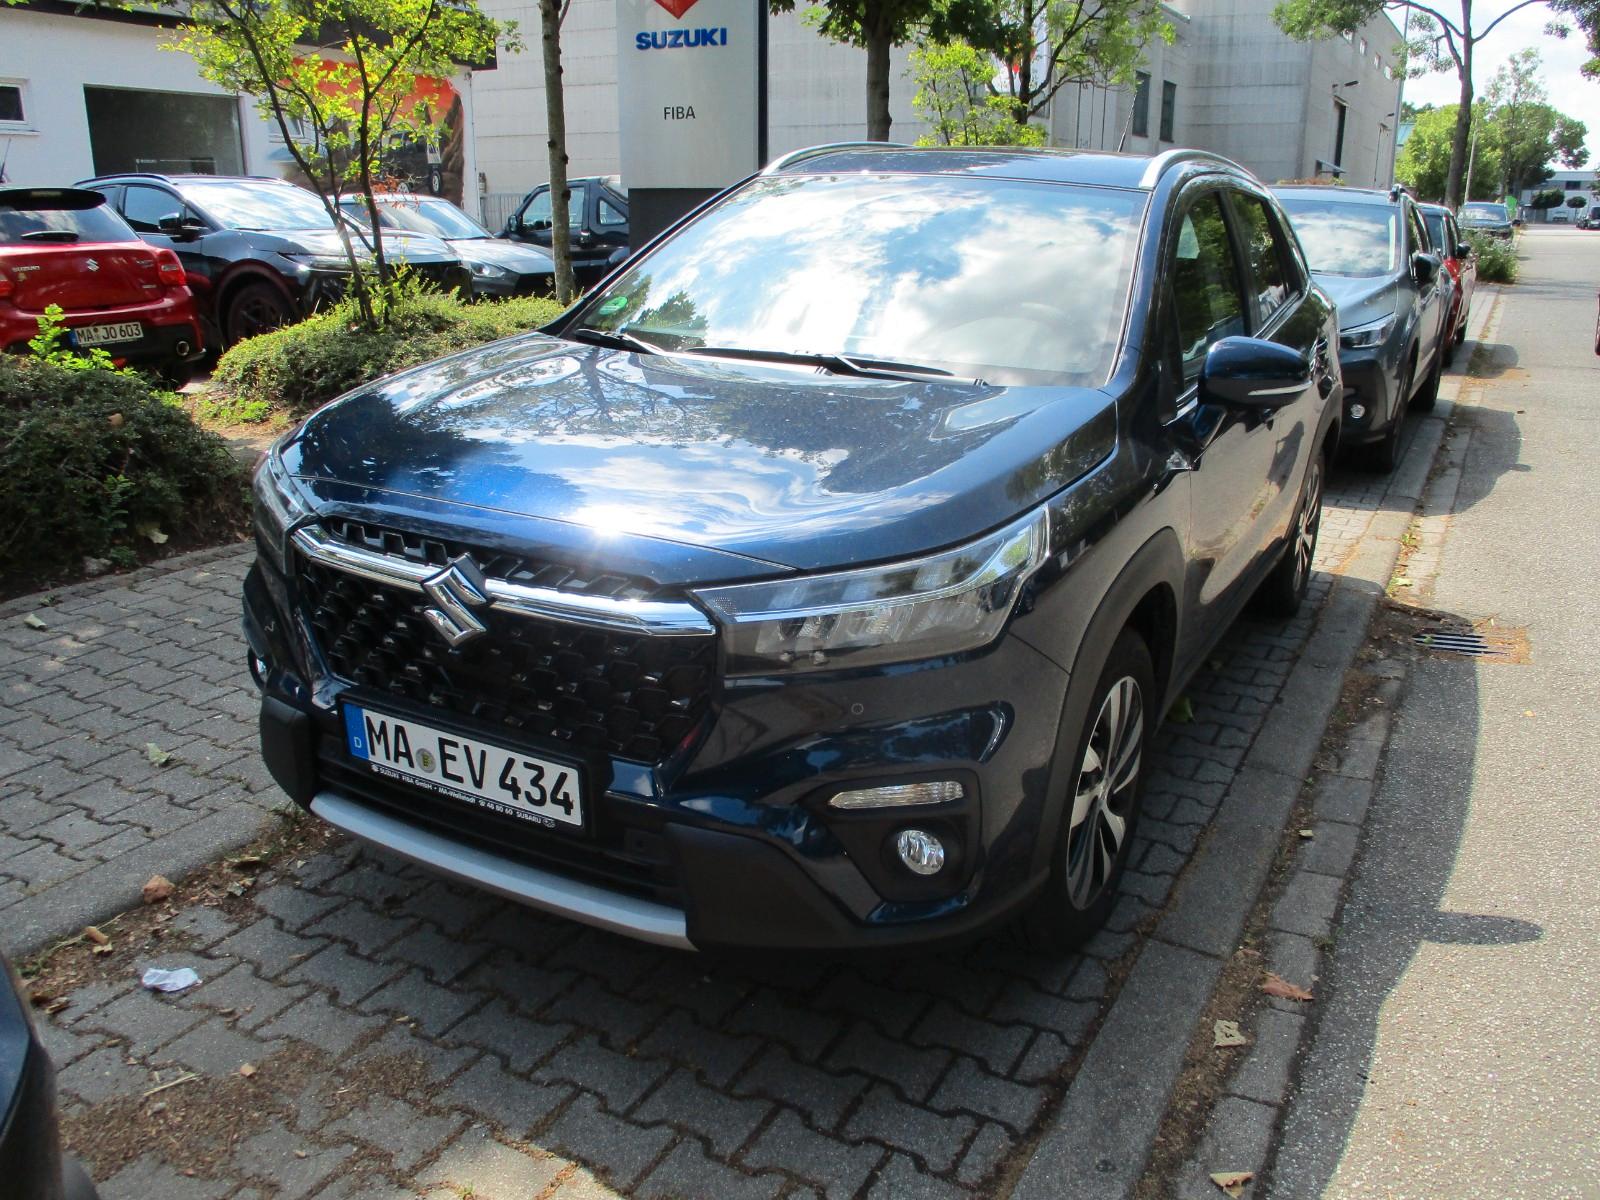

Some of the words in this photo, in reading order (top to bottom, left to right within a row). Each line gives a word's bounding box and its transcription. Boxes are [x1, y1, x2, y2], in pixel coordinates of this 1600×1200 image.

[635, 27, 728, 50] SUZUKI
[663, 105, 696, 120] FIBA
[77, 328, 95, 343] MA
[102, 326, 117, 340] JO
[119, 323, 141, 338] 603
[353, 735, 362, 749] D
[365, 715, 415, 769] MA
[437, 736, 487, 789] EV
[498, 757, 575, 816] 434
